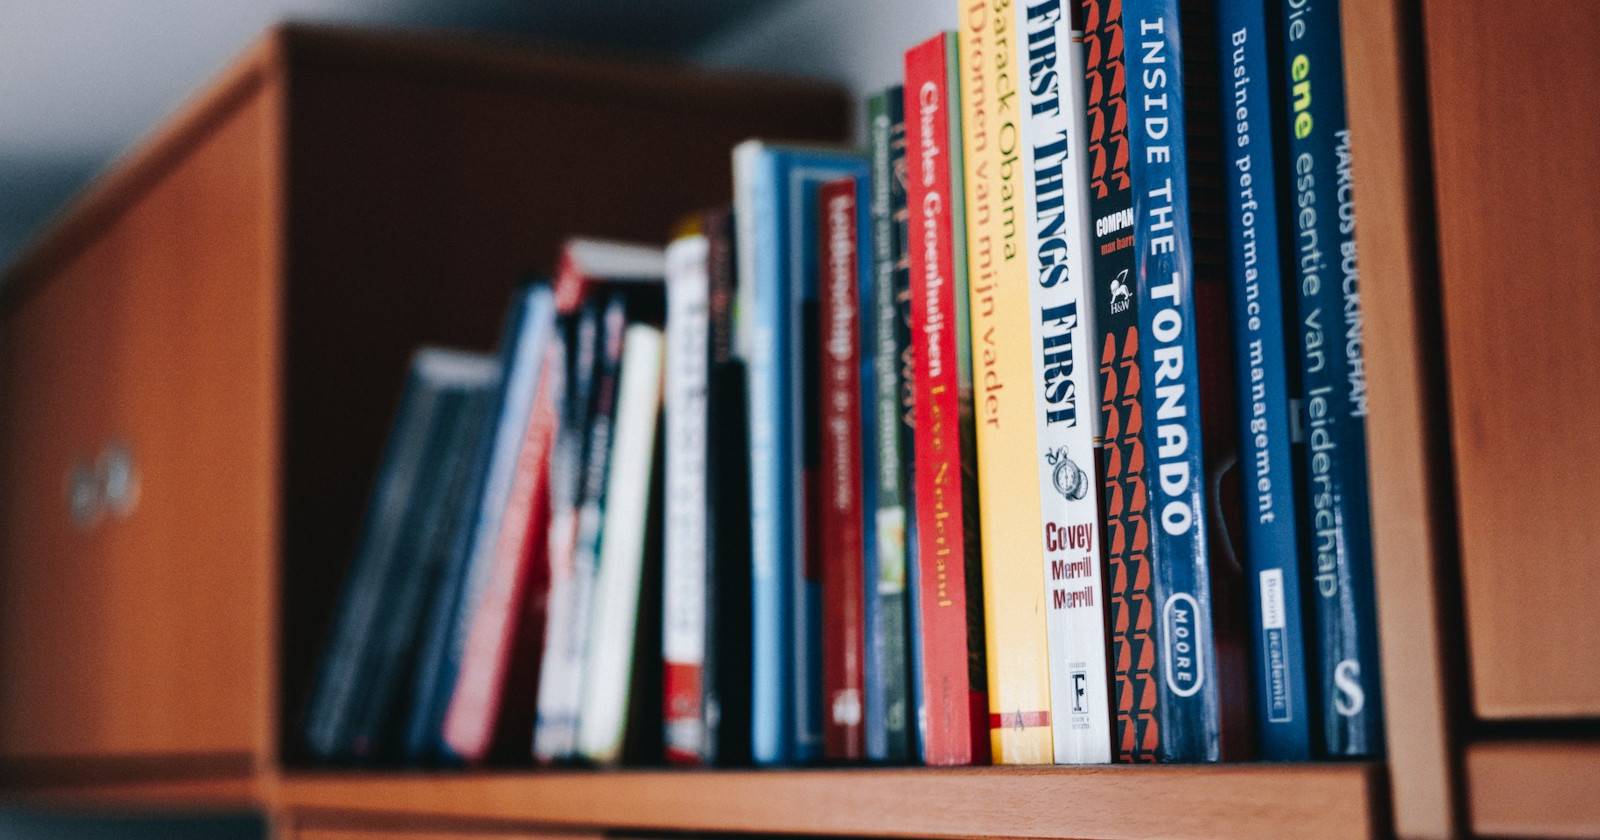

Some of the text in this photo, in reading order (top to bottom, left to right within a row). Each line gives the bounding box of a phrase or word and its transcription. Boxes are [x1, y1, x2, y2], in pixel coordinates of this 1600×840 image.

[919, 80, 939, 186] Charles
[1291, 54, 1313, 140] ene
[968, 2, 1004, 429] Dromen van mijn vader
[1000, 121, 1018, 261] Obama
[1026, 0, 1078, 428] FIRST THINGS FIRST
[1296, 152, 1328, 296] essentie
[923, 191, 944, 377] Groenhuijsen
[1110, 299, 1129, 315] H&W
[1140, 17, 1192, 536] INSIDE THE TORNADO
[1232, 27, 1275, 525] Business performance management
[1334, 130, 1368, 418] MARCUS BUCKINGHAM
[1305, 309, 1326, 374] van
[1046, 521, 1093, 552] Covey
[1308, 386, 1338, 598] leiderschap
[1051, 556, 1092, 580] Merrill
[1053, 586, 1094, 610] Merrill
[1174, 608, 1191, 682] MOORE
[1269, 630, 1286, 710] academic
[1334, 660, 1365, 717] S
